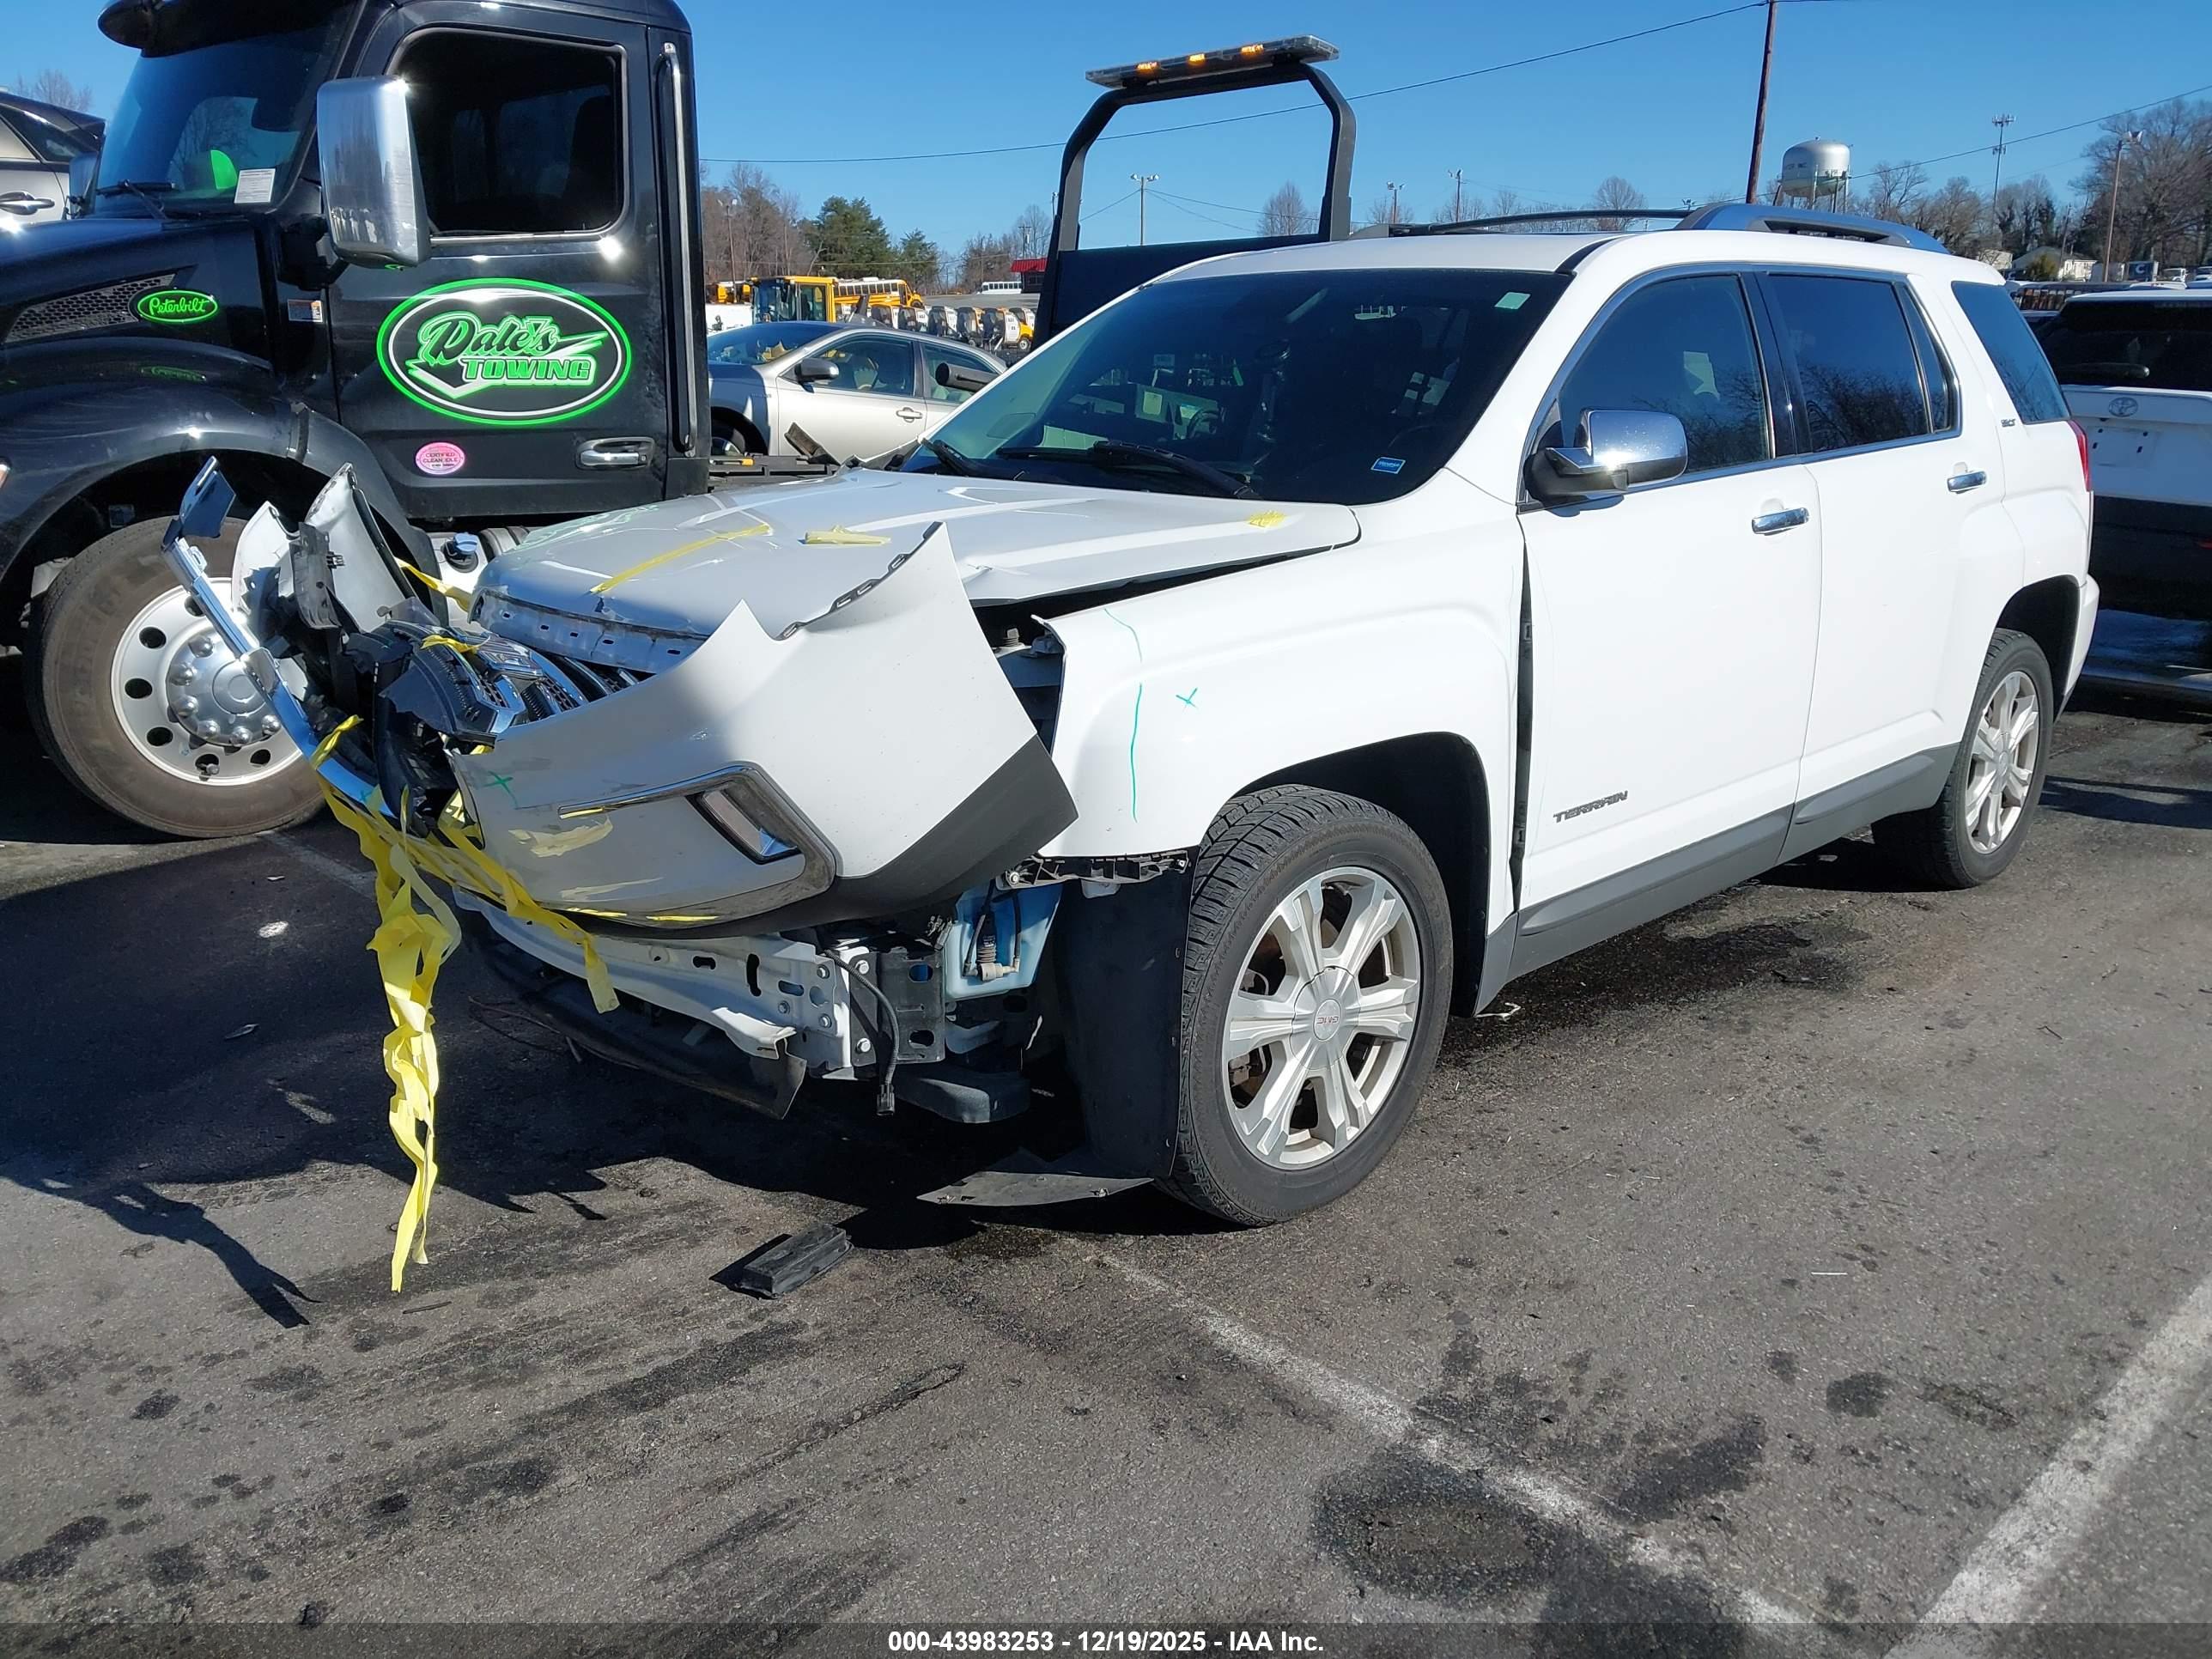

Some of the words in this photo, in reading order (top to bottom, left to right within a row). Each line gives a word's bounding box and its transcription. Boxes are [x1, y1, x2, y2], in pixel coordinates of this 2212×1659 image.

[149, 296, 211, 316] Peterbilt
[421, 313, 557, 363] Dale's
[460, 356, 592, 381] TOWING
[1553, 790, 1628, 823] TERRAIN
